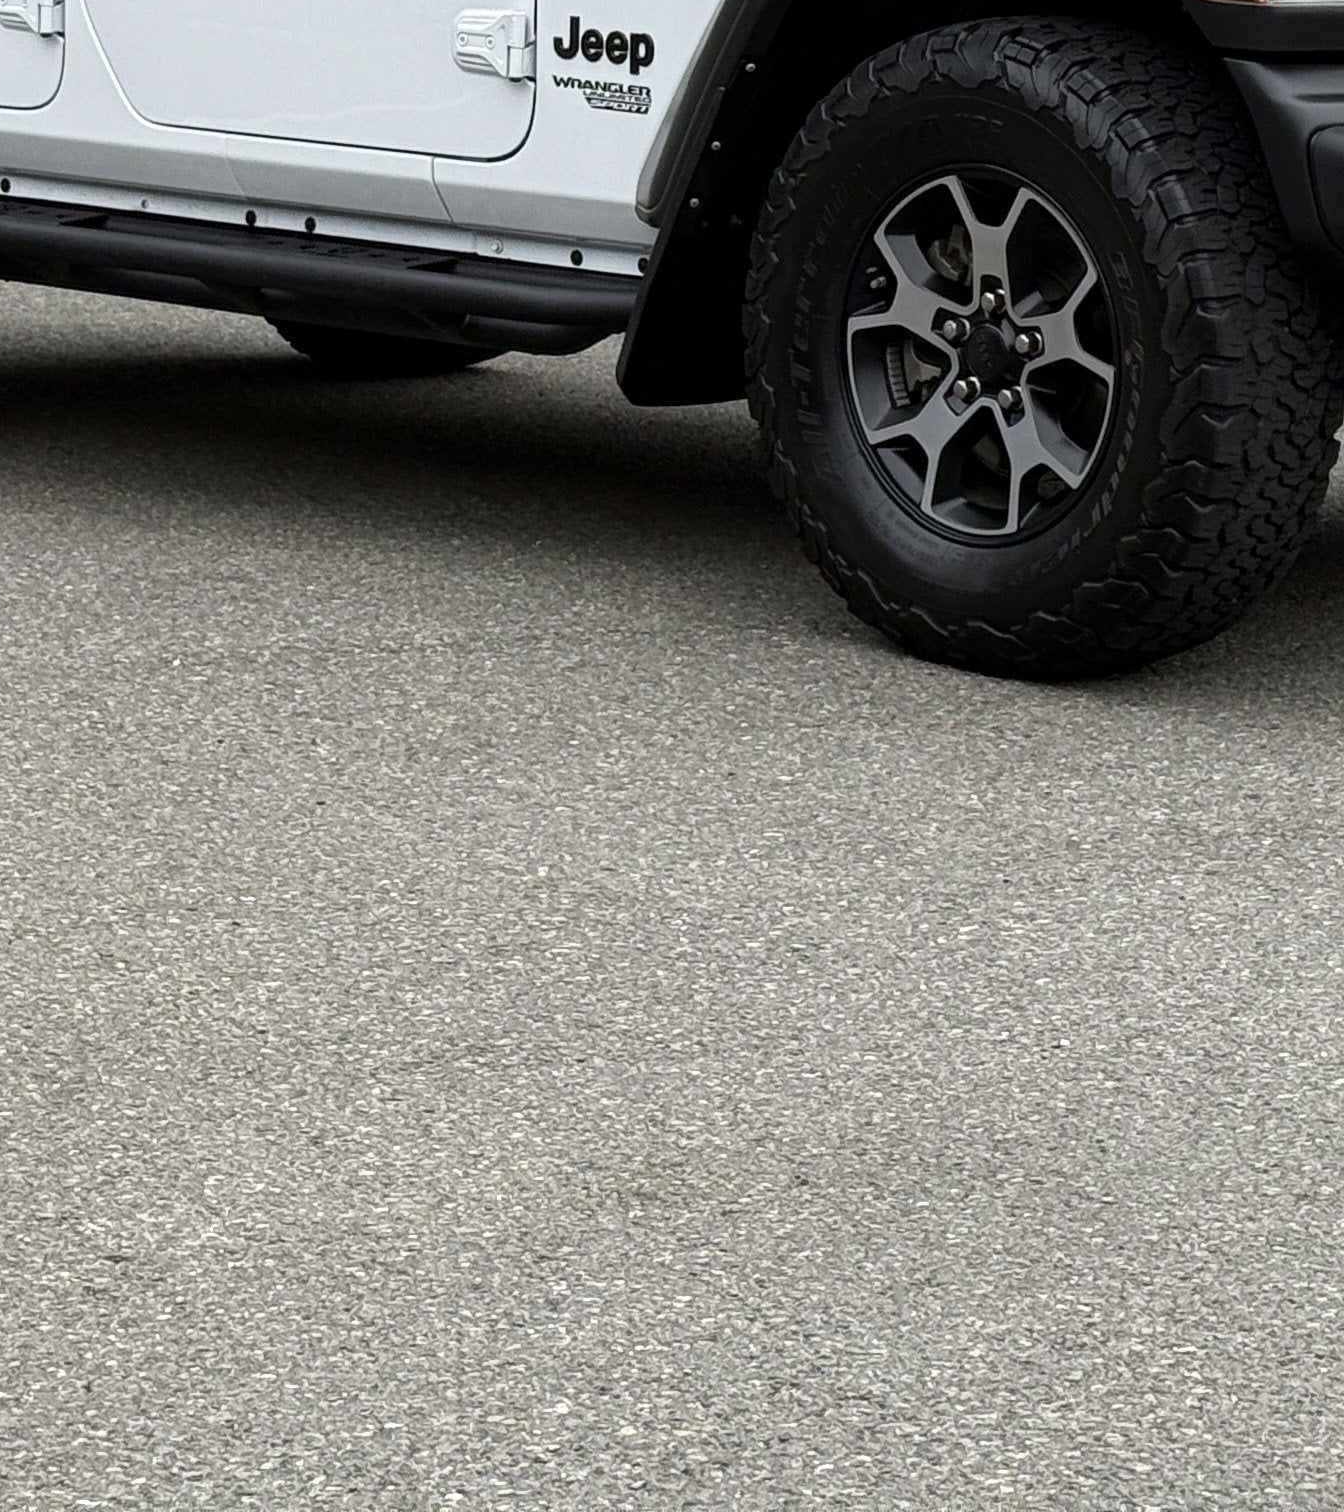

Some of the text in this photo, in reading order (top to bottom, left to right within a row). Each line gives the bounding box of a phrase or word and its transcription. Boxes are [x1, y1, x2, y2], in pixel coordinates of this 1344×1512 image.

[553, 16, 655, 75] Jeep
[551, 74, 651, 97] WRANGLER
[582, 90, 652, 104] UNLIMITED
[589, 99, 649, 113] SPORT
